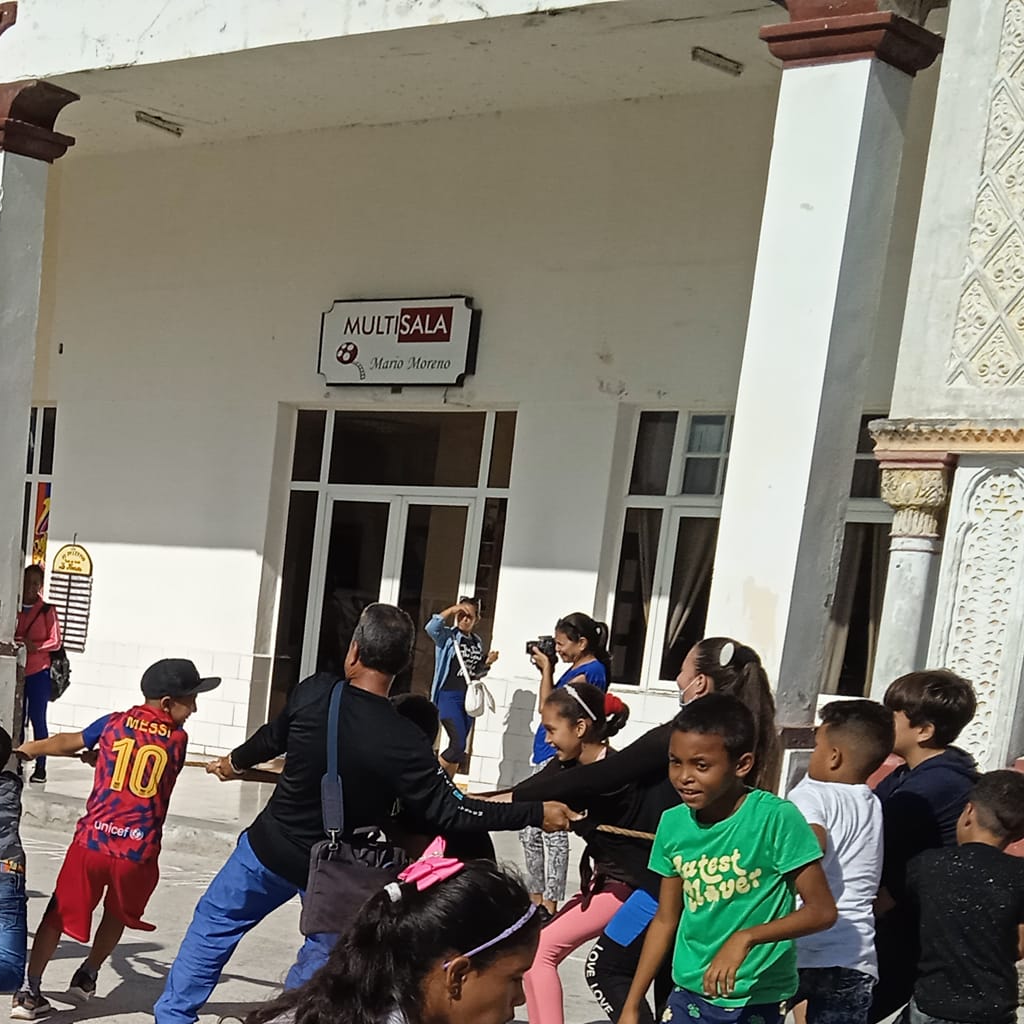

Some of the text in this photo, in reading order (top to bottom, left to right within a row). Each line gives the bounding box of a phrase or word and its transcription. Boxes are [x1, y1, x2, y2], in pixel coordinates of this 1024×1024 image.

[369, 356, 451, 370] Mario Moreno
[126, 716, 172, 738] MESSI
[110, 737, 168, 799] 10
[94, 820, 131, 838] unicef
[586, 944, 614, 1014] LOVE LOVE
